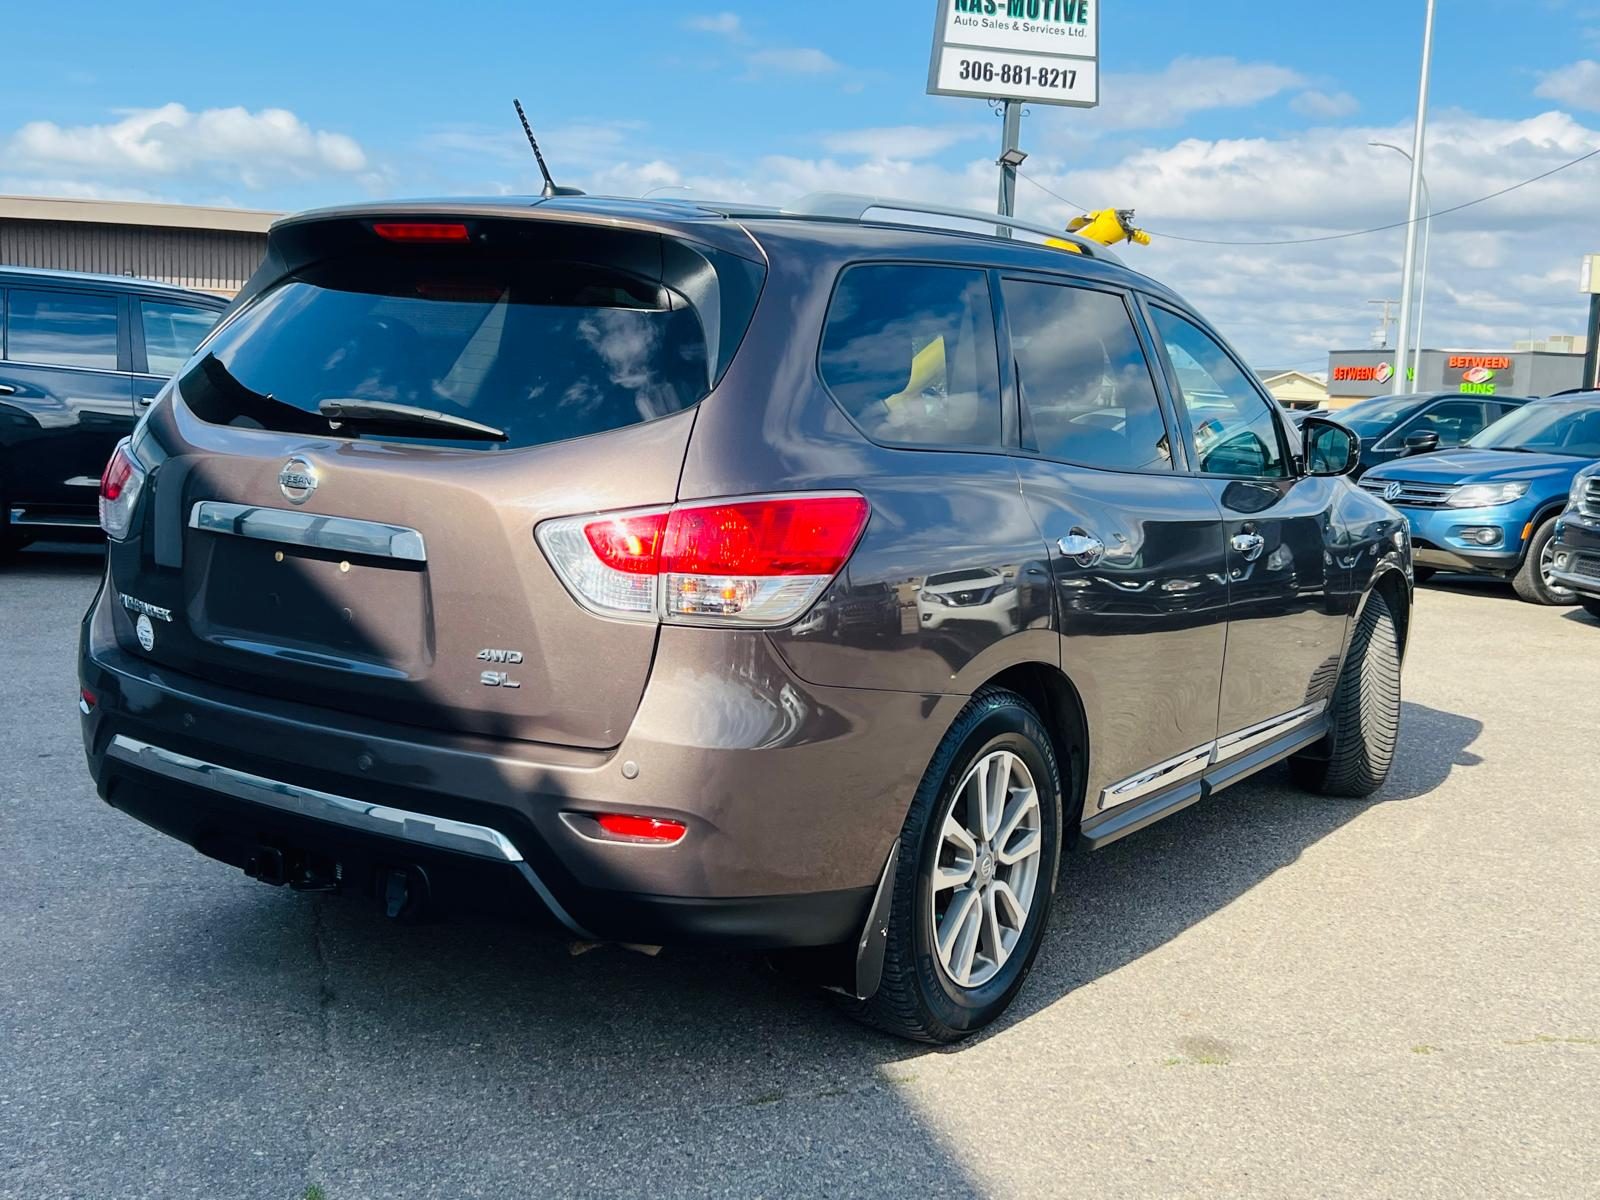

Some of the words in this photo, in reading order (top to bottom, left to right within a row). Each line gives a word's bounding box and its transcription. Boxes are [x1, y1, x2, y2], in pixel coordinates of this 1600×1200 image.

[954, 15, 979, 27] Auto
[981, 18, 1010, 30] Sales
[1012, 21, 1020, 31] &
[1022, 22, 1066, 36] Services
[1068, 26, 1088, 38] Ltd.
[959, 59, 1077, 89] 306-881-8217
[1449, 356, 1508, 369] BETWEEN
[1333, 367, 1375, 381] BETWEEN
[1459, 383, 1495, 395] BUNS
[476, 648, 523, 664] 4WD
[480, 671, 521, 688] SL
